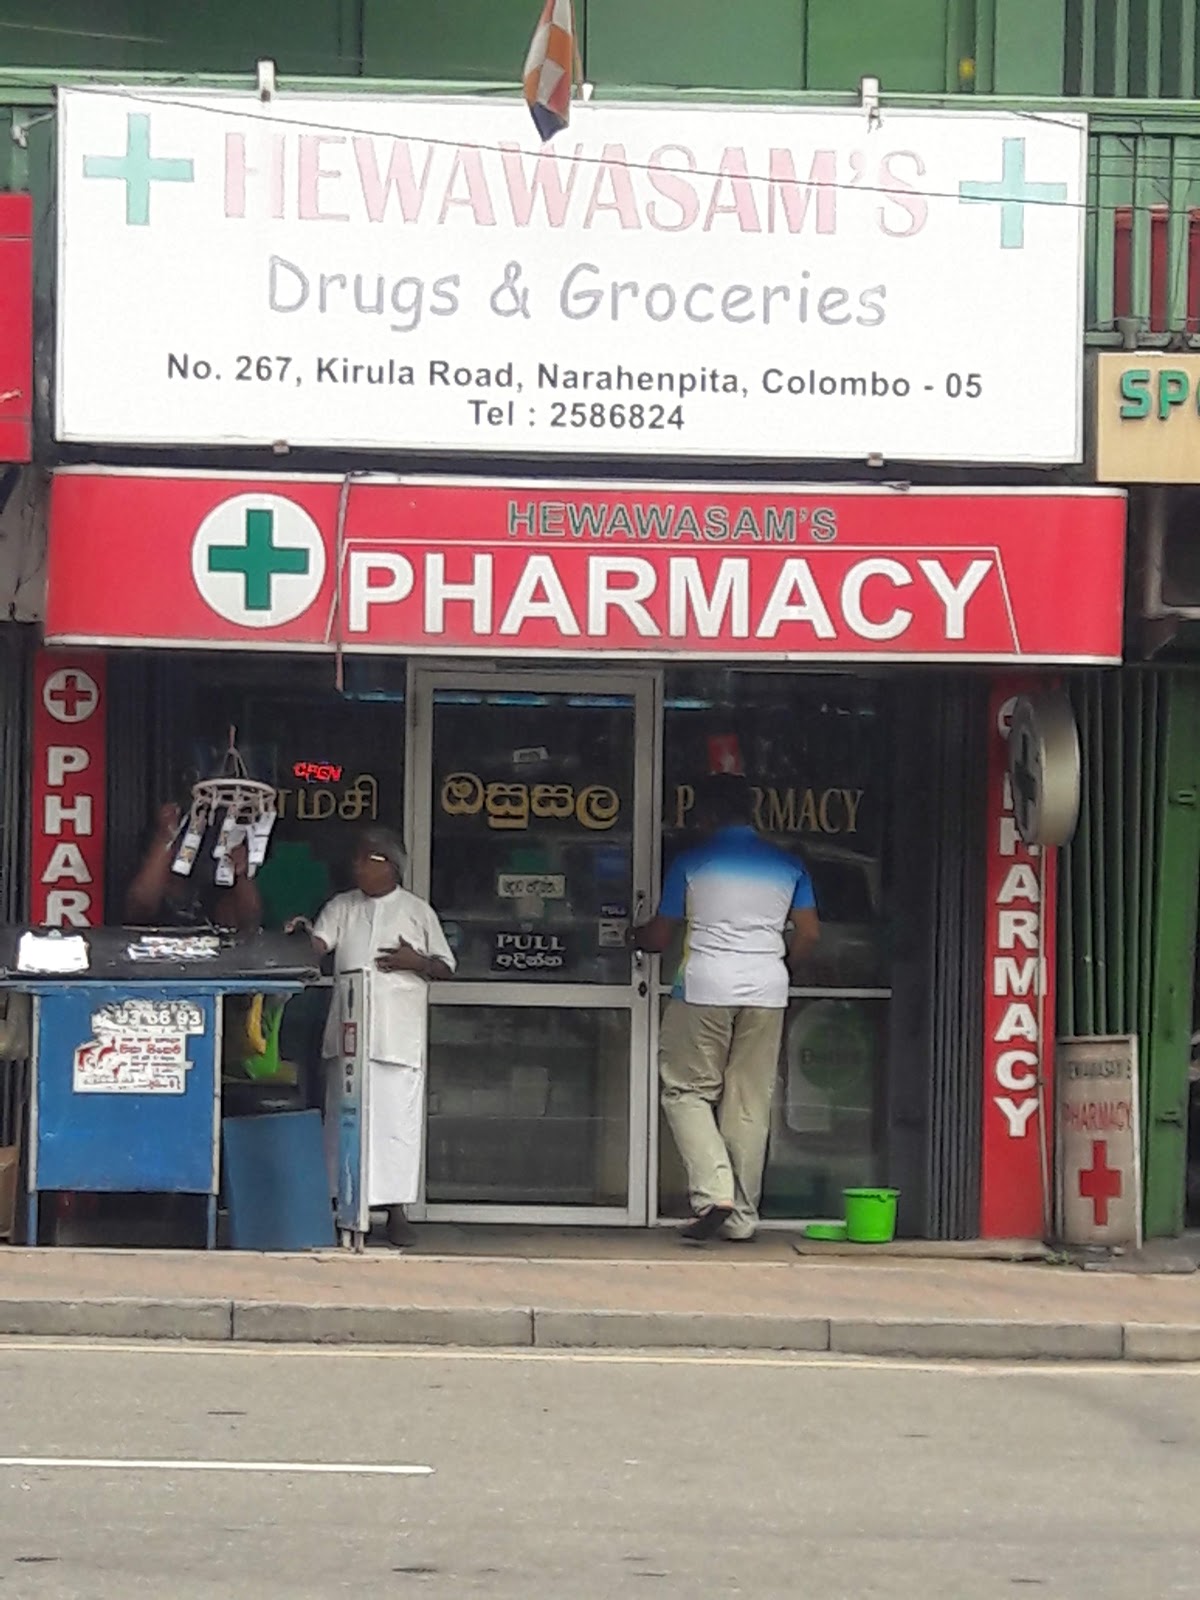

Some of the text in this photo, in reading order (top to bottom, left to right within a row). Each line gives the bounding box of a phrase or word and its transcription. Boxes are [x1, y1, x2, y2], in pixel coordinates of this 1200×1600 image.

[223, 131, 930, 238] HEWAWASAM'S
[268, 254, 887, 332] Drugs & Groceries
[168, 353, 221, 380] No.
[235, 355, 302, 384] 267,
[317, 357, 414, 385] Kirula
[429, 360, 523, 390] Road,
[538, 363, 748, 398] Narahenpita,
[762, 368, 910, 397] Colombo
[946, 372, 982, 398] 05
[1120, 369, 1200, 421] SP
[467, 399, 514, 426] Tel
[550, 401, 685, 430] 2586824
[507, 500, 838, 543] HEWAWASAM'S
[348, 551, 994, 641] PHARMACY
[675, 784, 864, 834] PRMACY
[497, 933, 566, 951] PULL
[993, 770, 1046, 1137] HARMACY
